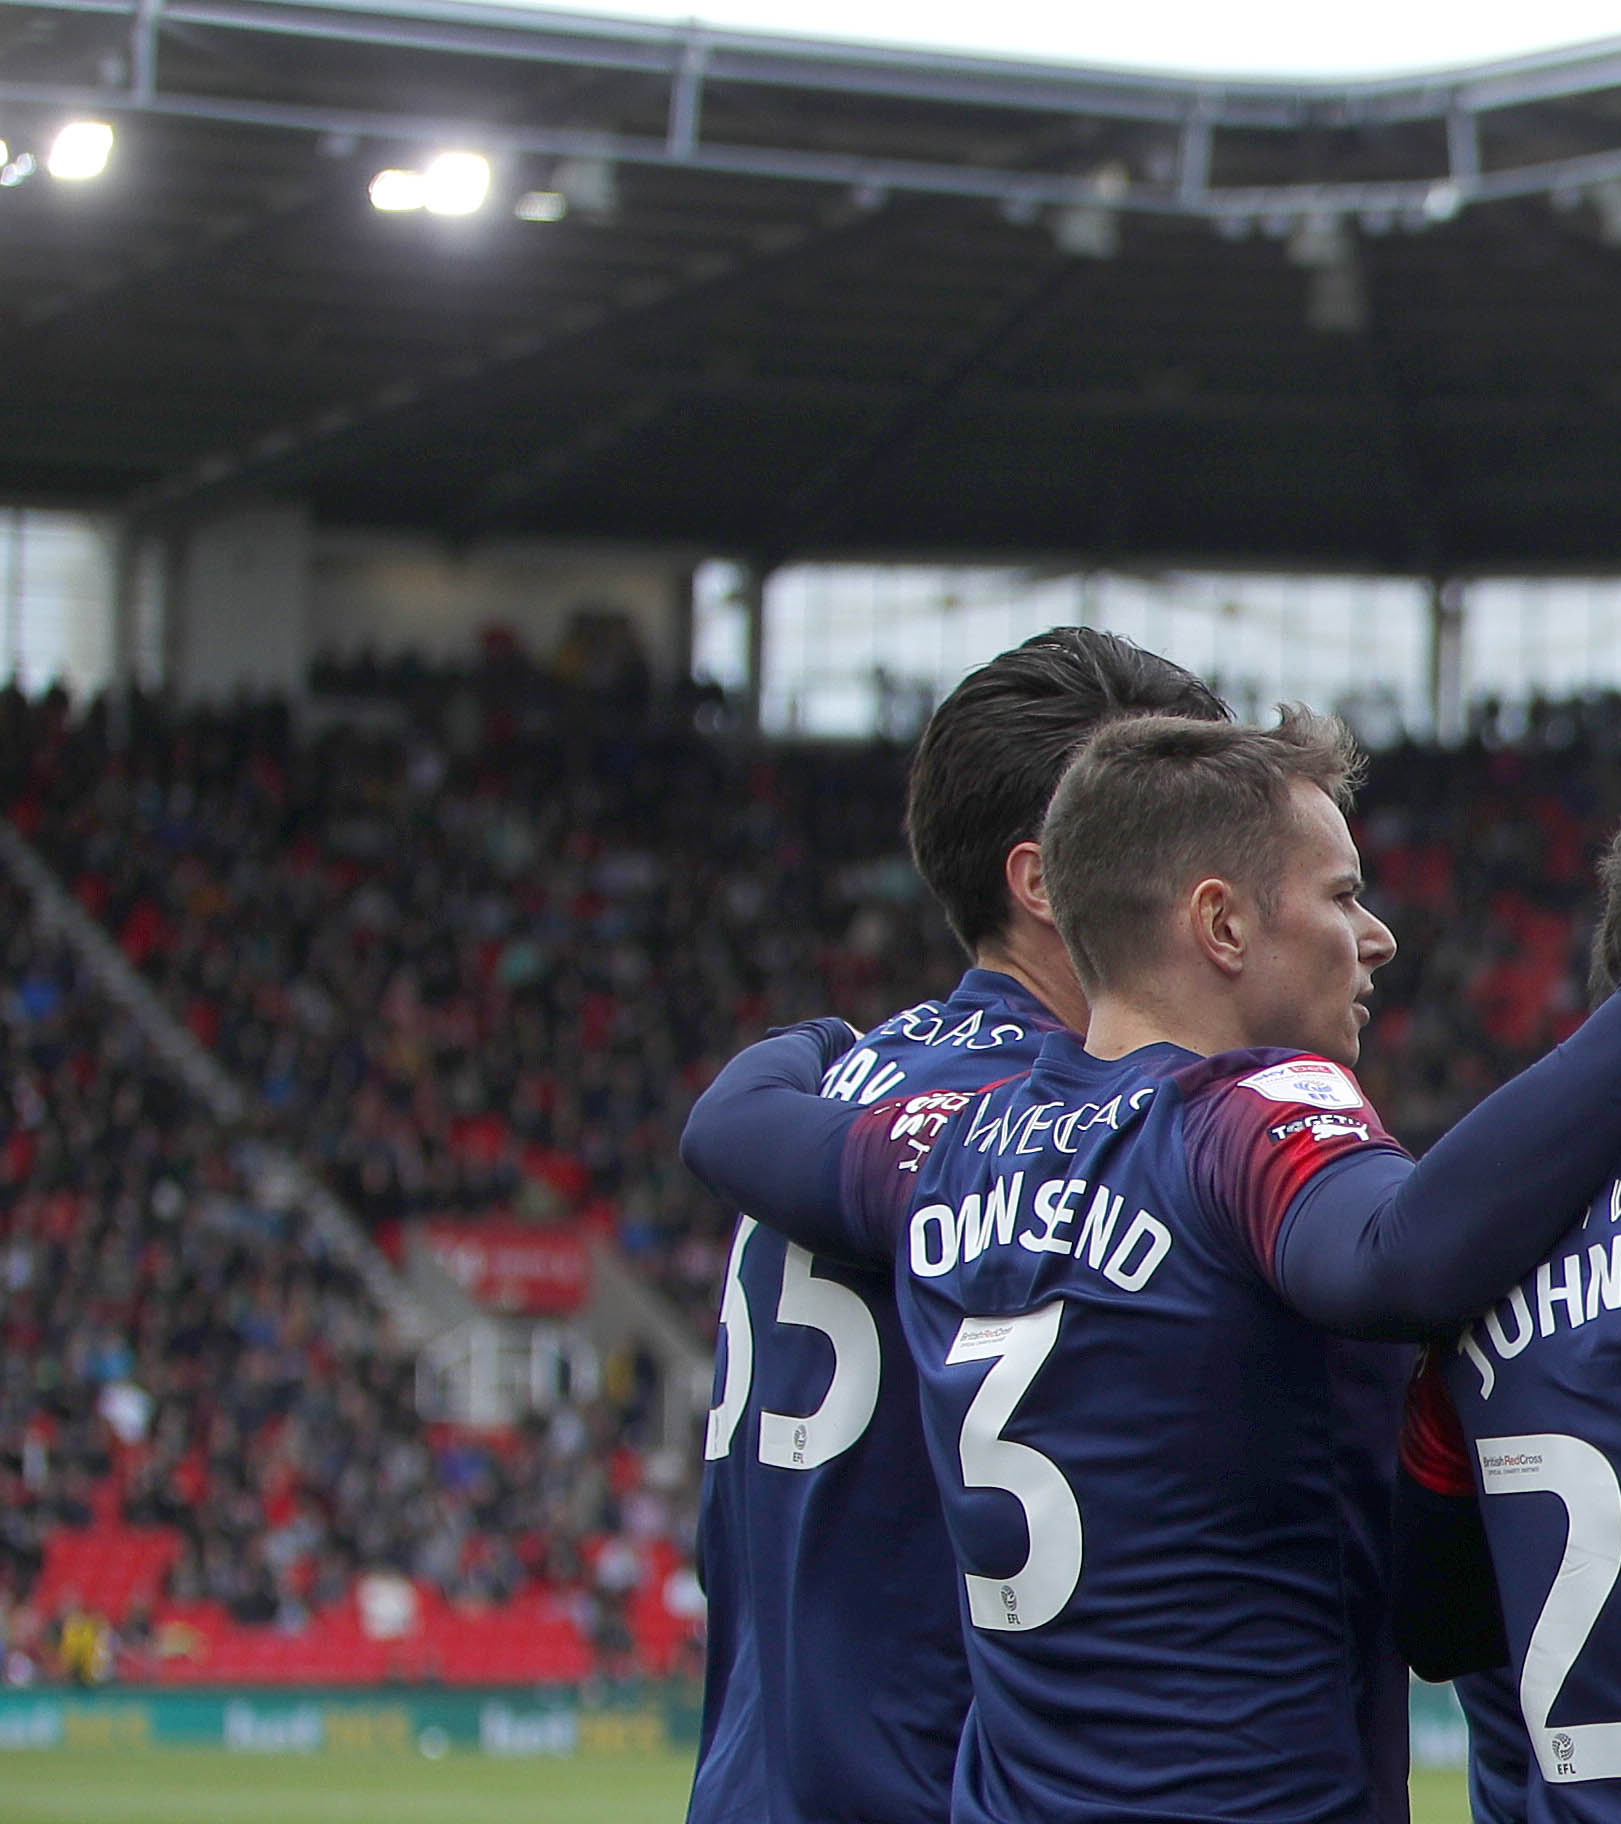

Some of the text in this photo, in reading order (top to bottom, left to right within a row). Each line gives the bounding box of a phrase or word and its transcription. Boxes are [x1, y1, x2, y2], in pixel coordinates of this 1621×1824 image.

[1308, 1093, 1341, 1102] EFL
[945, 1300, 1083, 1632] 3
[1557, 1763, 1577, 1775] EFL
